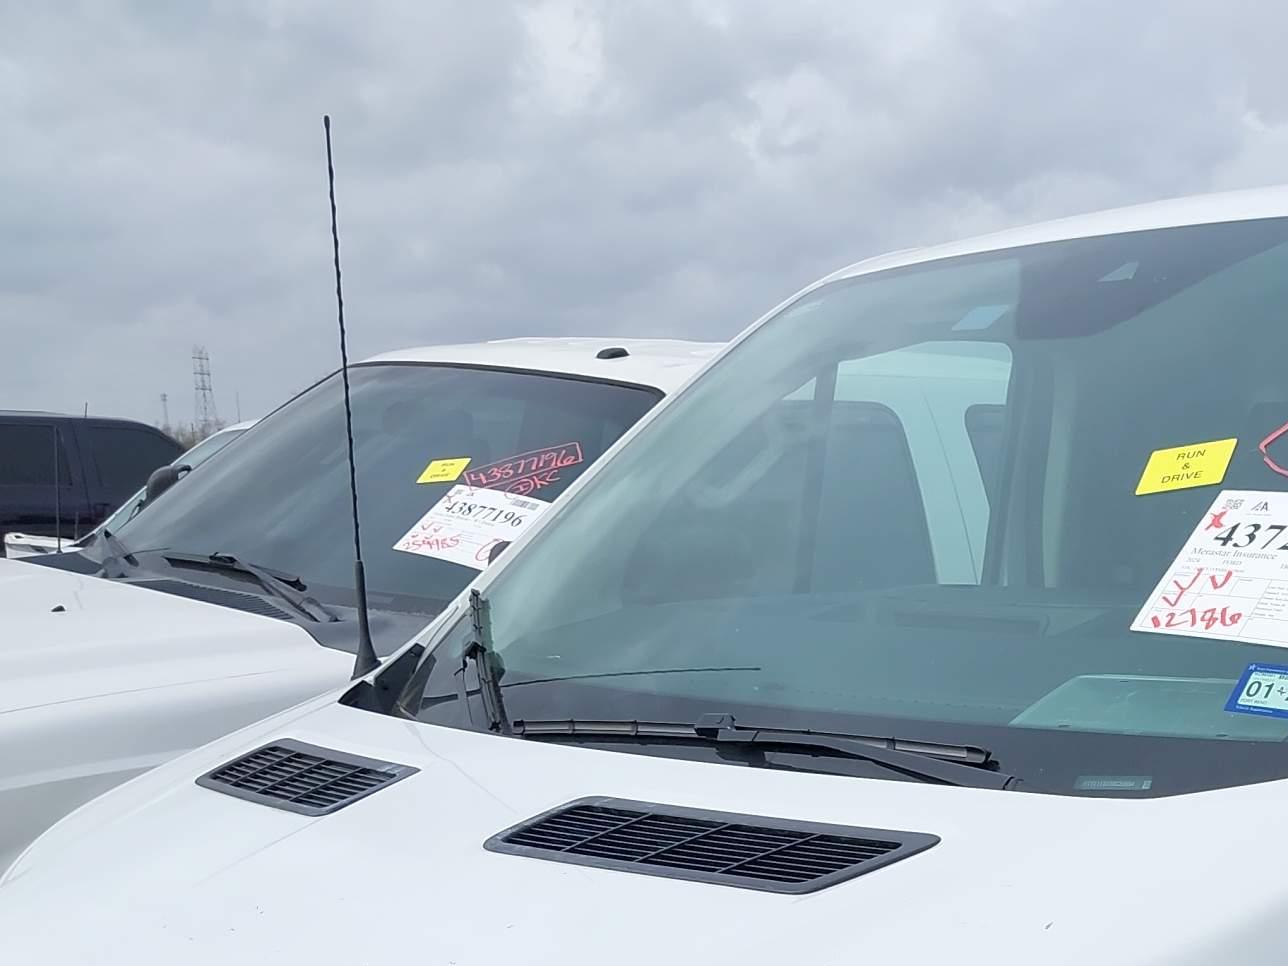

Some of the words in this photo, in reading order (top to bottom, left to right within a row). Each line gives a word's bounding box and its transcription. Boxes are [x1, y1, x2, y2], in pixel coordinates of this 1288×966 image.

[1175, 449, 1207, 461] RUN
[469, 449, 576, 484] 43877196
[1181, 462, 1191, 471] &
[1160, 470, 1204, 484] DRIVE
[445, 501, 528, 528] 43877196
[1232, 550, 1279, 561] Insurance
[1245, 680, 1275, 699] 01
